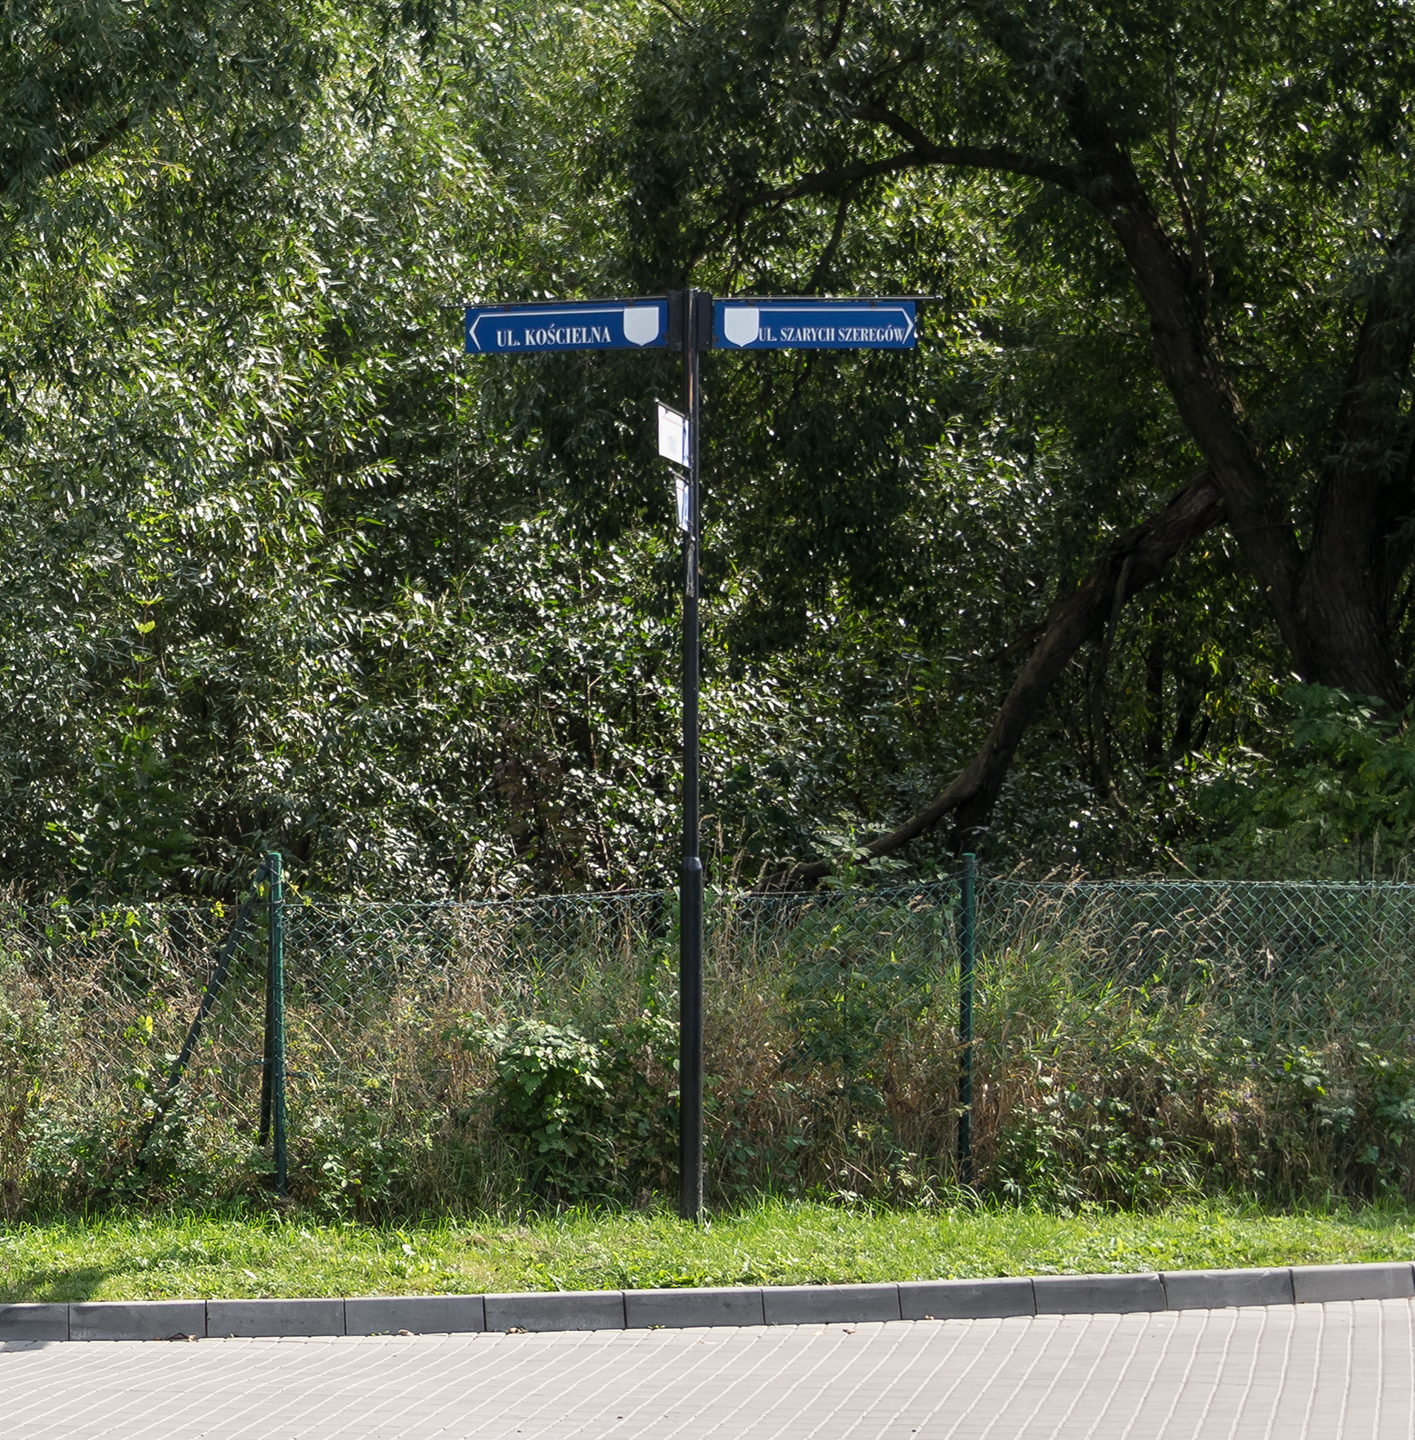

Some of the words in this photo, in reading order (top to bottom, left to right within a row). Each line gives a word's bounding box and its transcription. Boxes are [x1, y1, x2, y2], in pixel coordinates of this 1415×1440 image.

[496, 330, 521, 347] UL.
[524, 323, 612, 346] KOŚCIELNA
[758, 327, 777, 342] UL.
[780, 327, 835, 342] SZARYCH
[837, 324, 906, 342] SZEREGÓW
